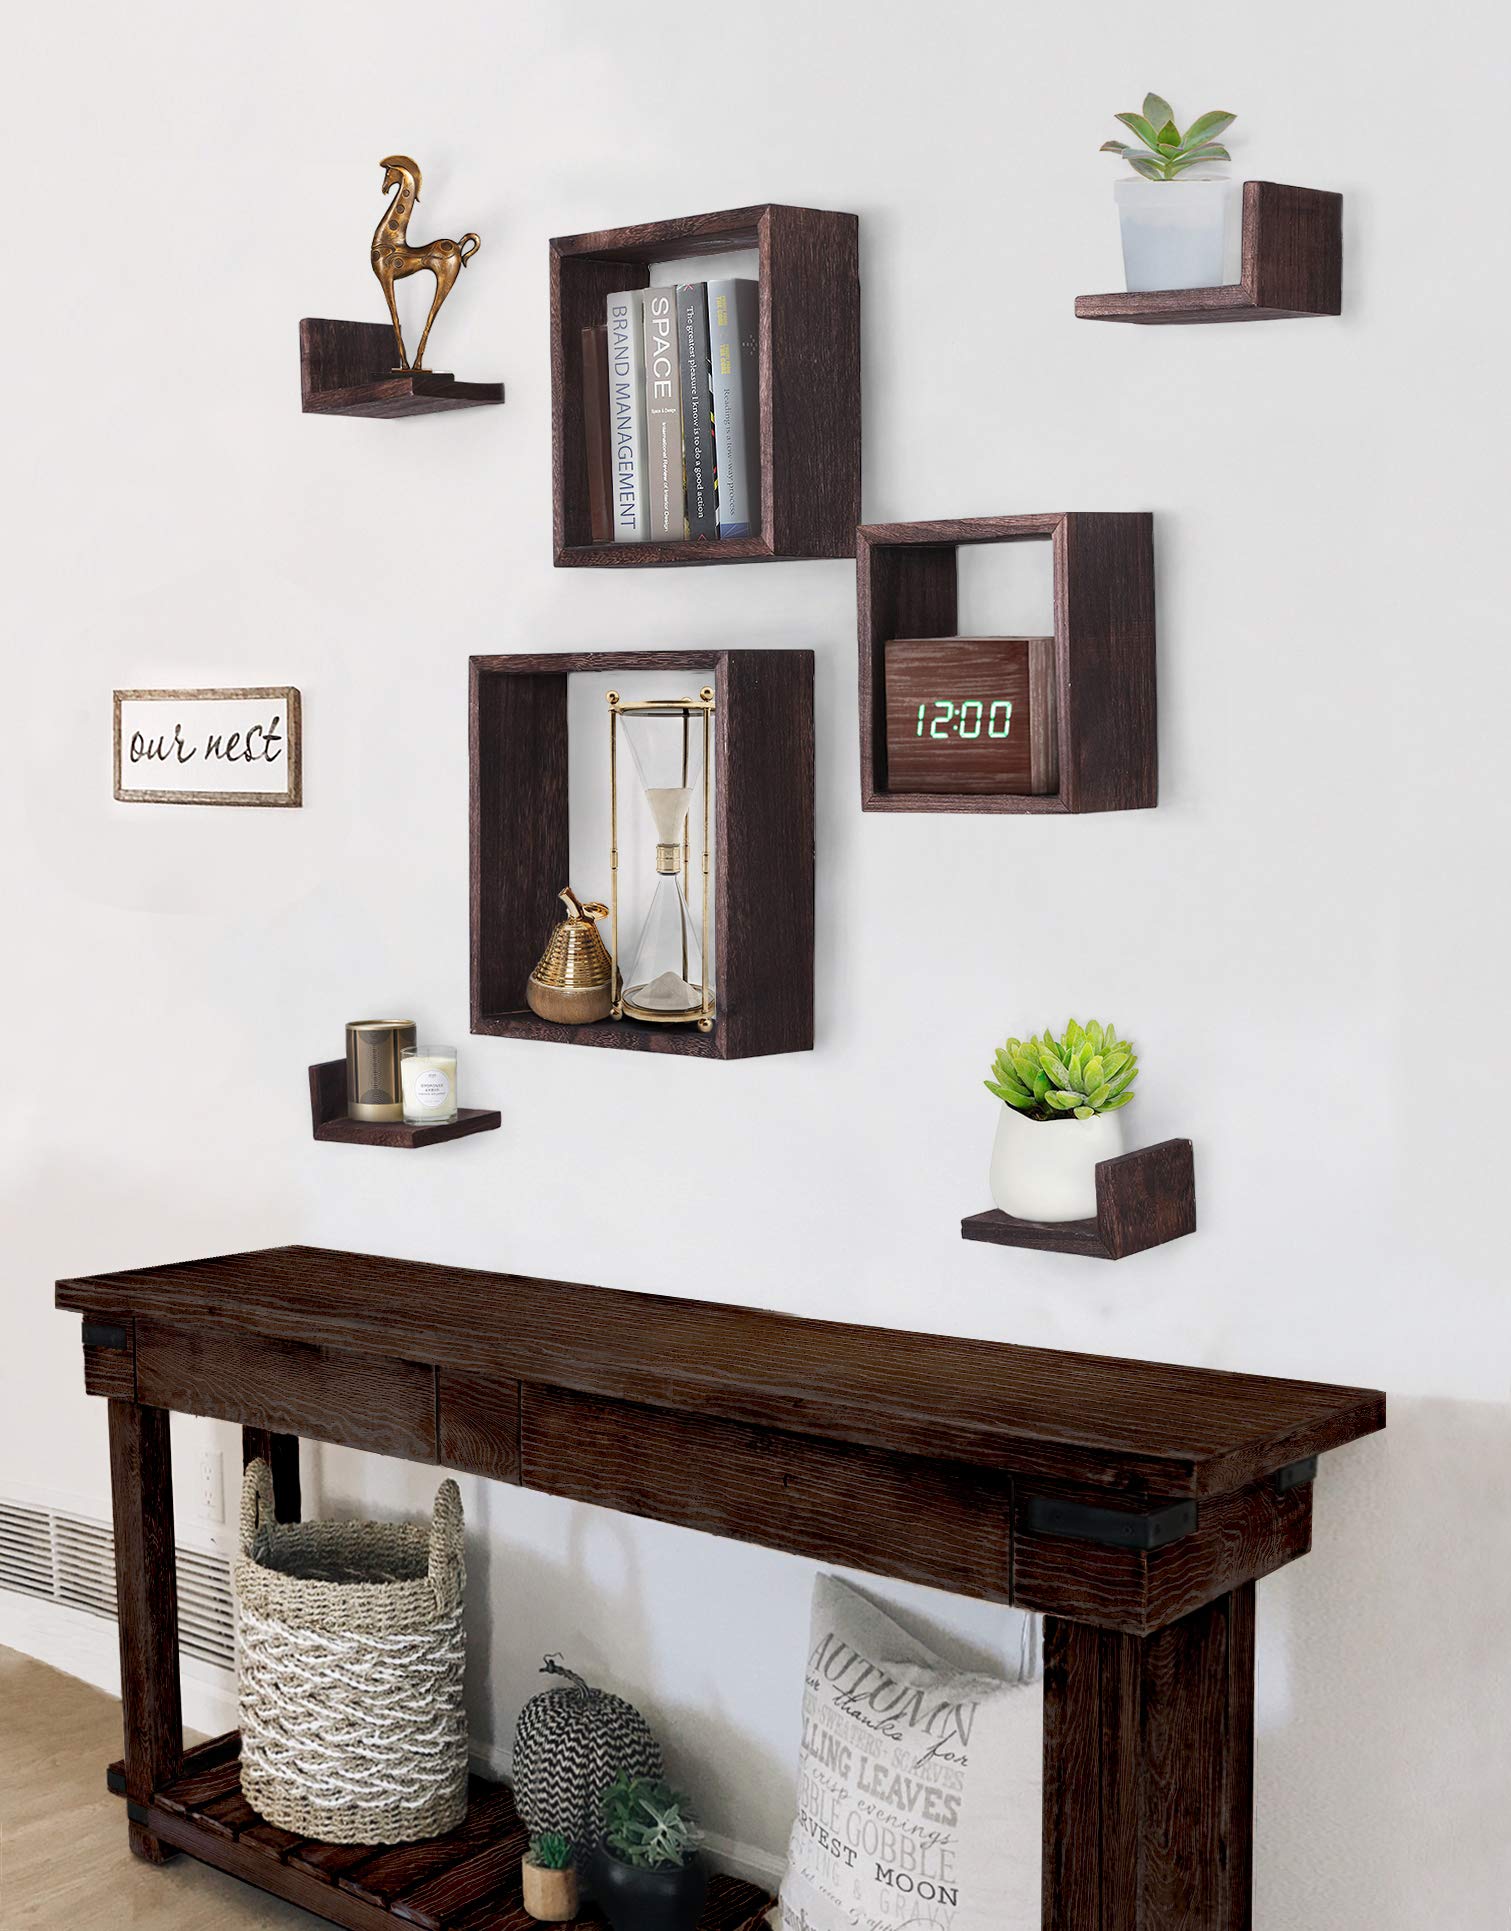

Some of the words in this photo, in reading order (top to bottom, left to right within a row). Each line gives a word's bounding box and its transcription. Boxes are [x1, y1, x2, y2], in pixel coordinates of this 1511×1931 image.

[686, 305, 695, 324] The
[612, 305, 630, 377] BRAND
[651, 297, 672, 399] SPACE
[686, 325, 696, 358] greatest
[688, 359, 697, 394] pleasure
[691, 401, 699, 427] know
[723, 388, 733, 425] Reading
[615, 383, 636, 530] MANAGEMENT
[694, 436, 700, 446] to
[694, 447, 702, 459] do
[693, 467, 704, 490] good
[727, 482, 736, 516] process
[697, 491, 705, 518] action
[130, 724, 197, 763] our
[205, 716, 282, 762] nest
[917, 701, 1012, 739] 12:00
[808, 1632, 980, 1746] AUTUMN
[831, 1684, 907, 1741] thanks
[913, 1730, 968, 1769] for
[801, 1716, 853, 1781] LLING
[856, 1756, 962, 1829] LEAVES
[890, 1747, 965, 1793] SCARVES
[857, 1800, 959, 1849] evenings
[798, 1808, 858, 1868] RVEST
[875, 1862, 959, 1907] MOON
[846, 1810, 957, 1885] GOBBLE
